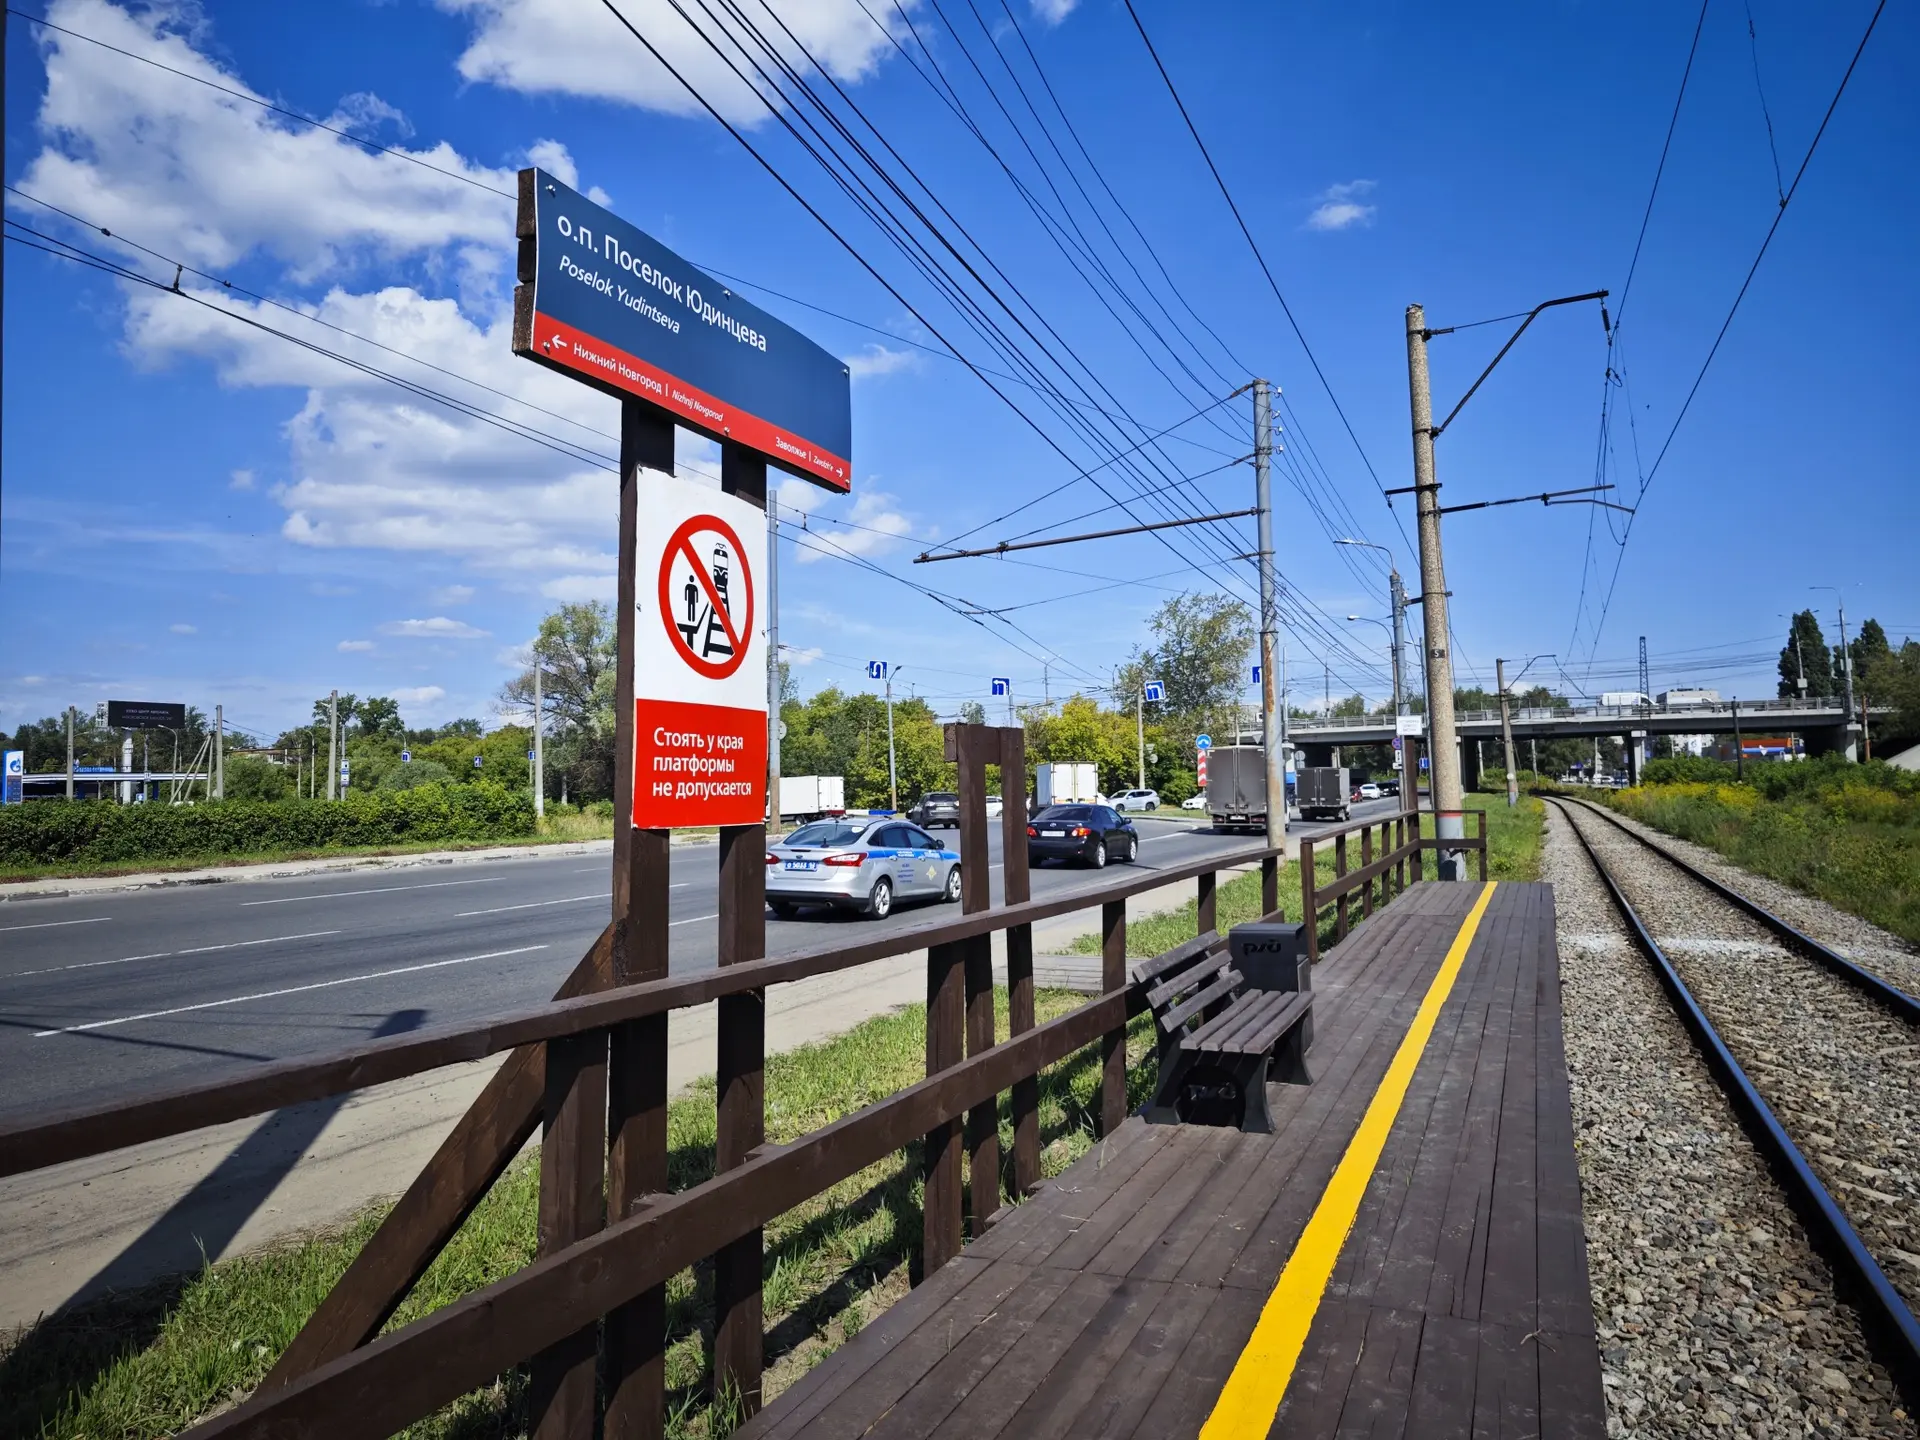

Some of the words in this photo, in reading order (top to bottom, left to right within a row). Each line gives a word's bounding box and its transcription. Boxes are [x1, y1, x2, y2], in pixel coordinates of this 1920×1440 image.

[557, 215, 598, 253] о.п.
[604, 234, 683, 304] Поселок
[686, 284, 767, 352] Юдинцева
[559, 254, 613, 297] Poselok
[617, 284, 681, 334] Yudintseva
[573, 342, 617, 373] Нижний
[618, 362, 662, 395] Новгород
[671, 389, 694, 410] Nizhnij
[693, 400, 724, 422] Novgorod
[775, 436, 807, 460] Заволжье
[653, 726, 705, 749] Стоять
[706, 734, 715, 753] у
[717, 735, 744, 754] края
[653, 753, 735, 777] платформы
[652, 781, 673, 797] не
[675, 781, 752, 801] допускается
